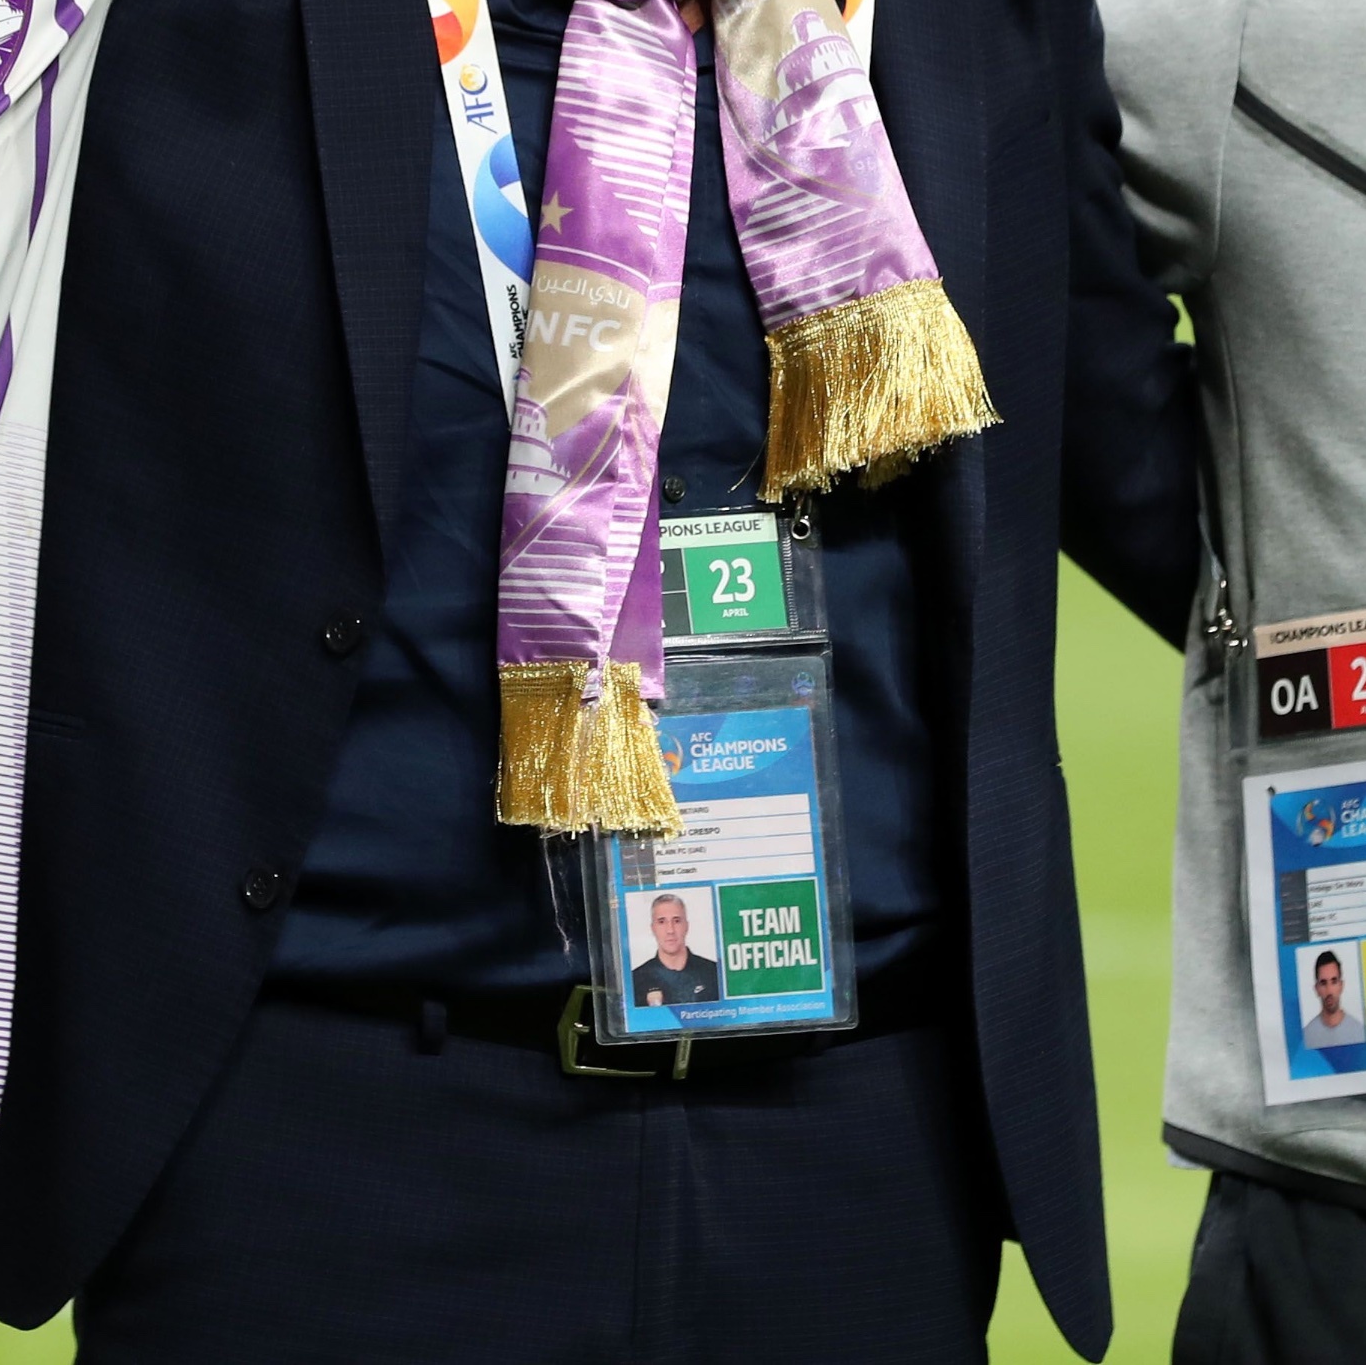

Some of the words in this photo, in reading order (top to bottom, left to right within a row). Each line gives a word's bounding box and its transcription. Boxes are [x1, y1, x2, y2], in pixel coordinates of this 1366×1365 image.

[459, 63, 498, 134] AFC
[562, 313, 622, 352] FC
[659, 523, 703, 538] PIONS
[706, 519, 762, 534] LEAGUE
[709, 558, 755, 604] 23
[722, 608, 749, 618] APRIL
[1271, 675, 1319, 716] OA
[690, 732, 712, 742] AFC
[690, 738, 787, 758] CHAMPIONS
[692, 755, 755, 773] LEAGUE
[738, 905, 801, 937] TEAM
[727, 938, 818, 971] OFFICIAL
[680, 1008, 737, 1020] Participating
